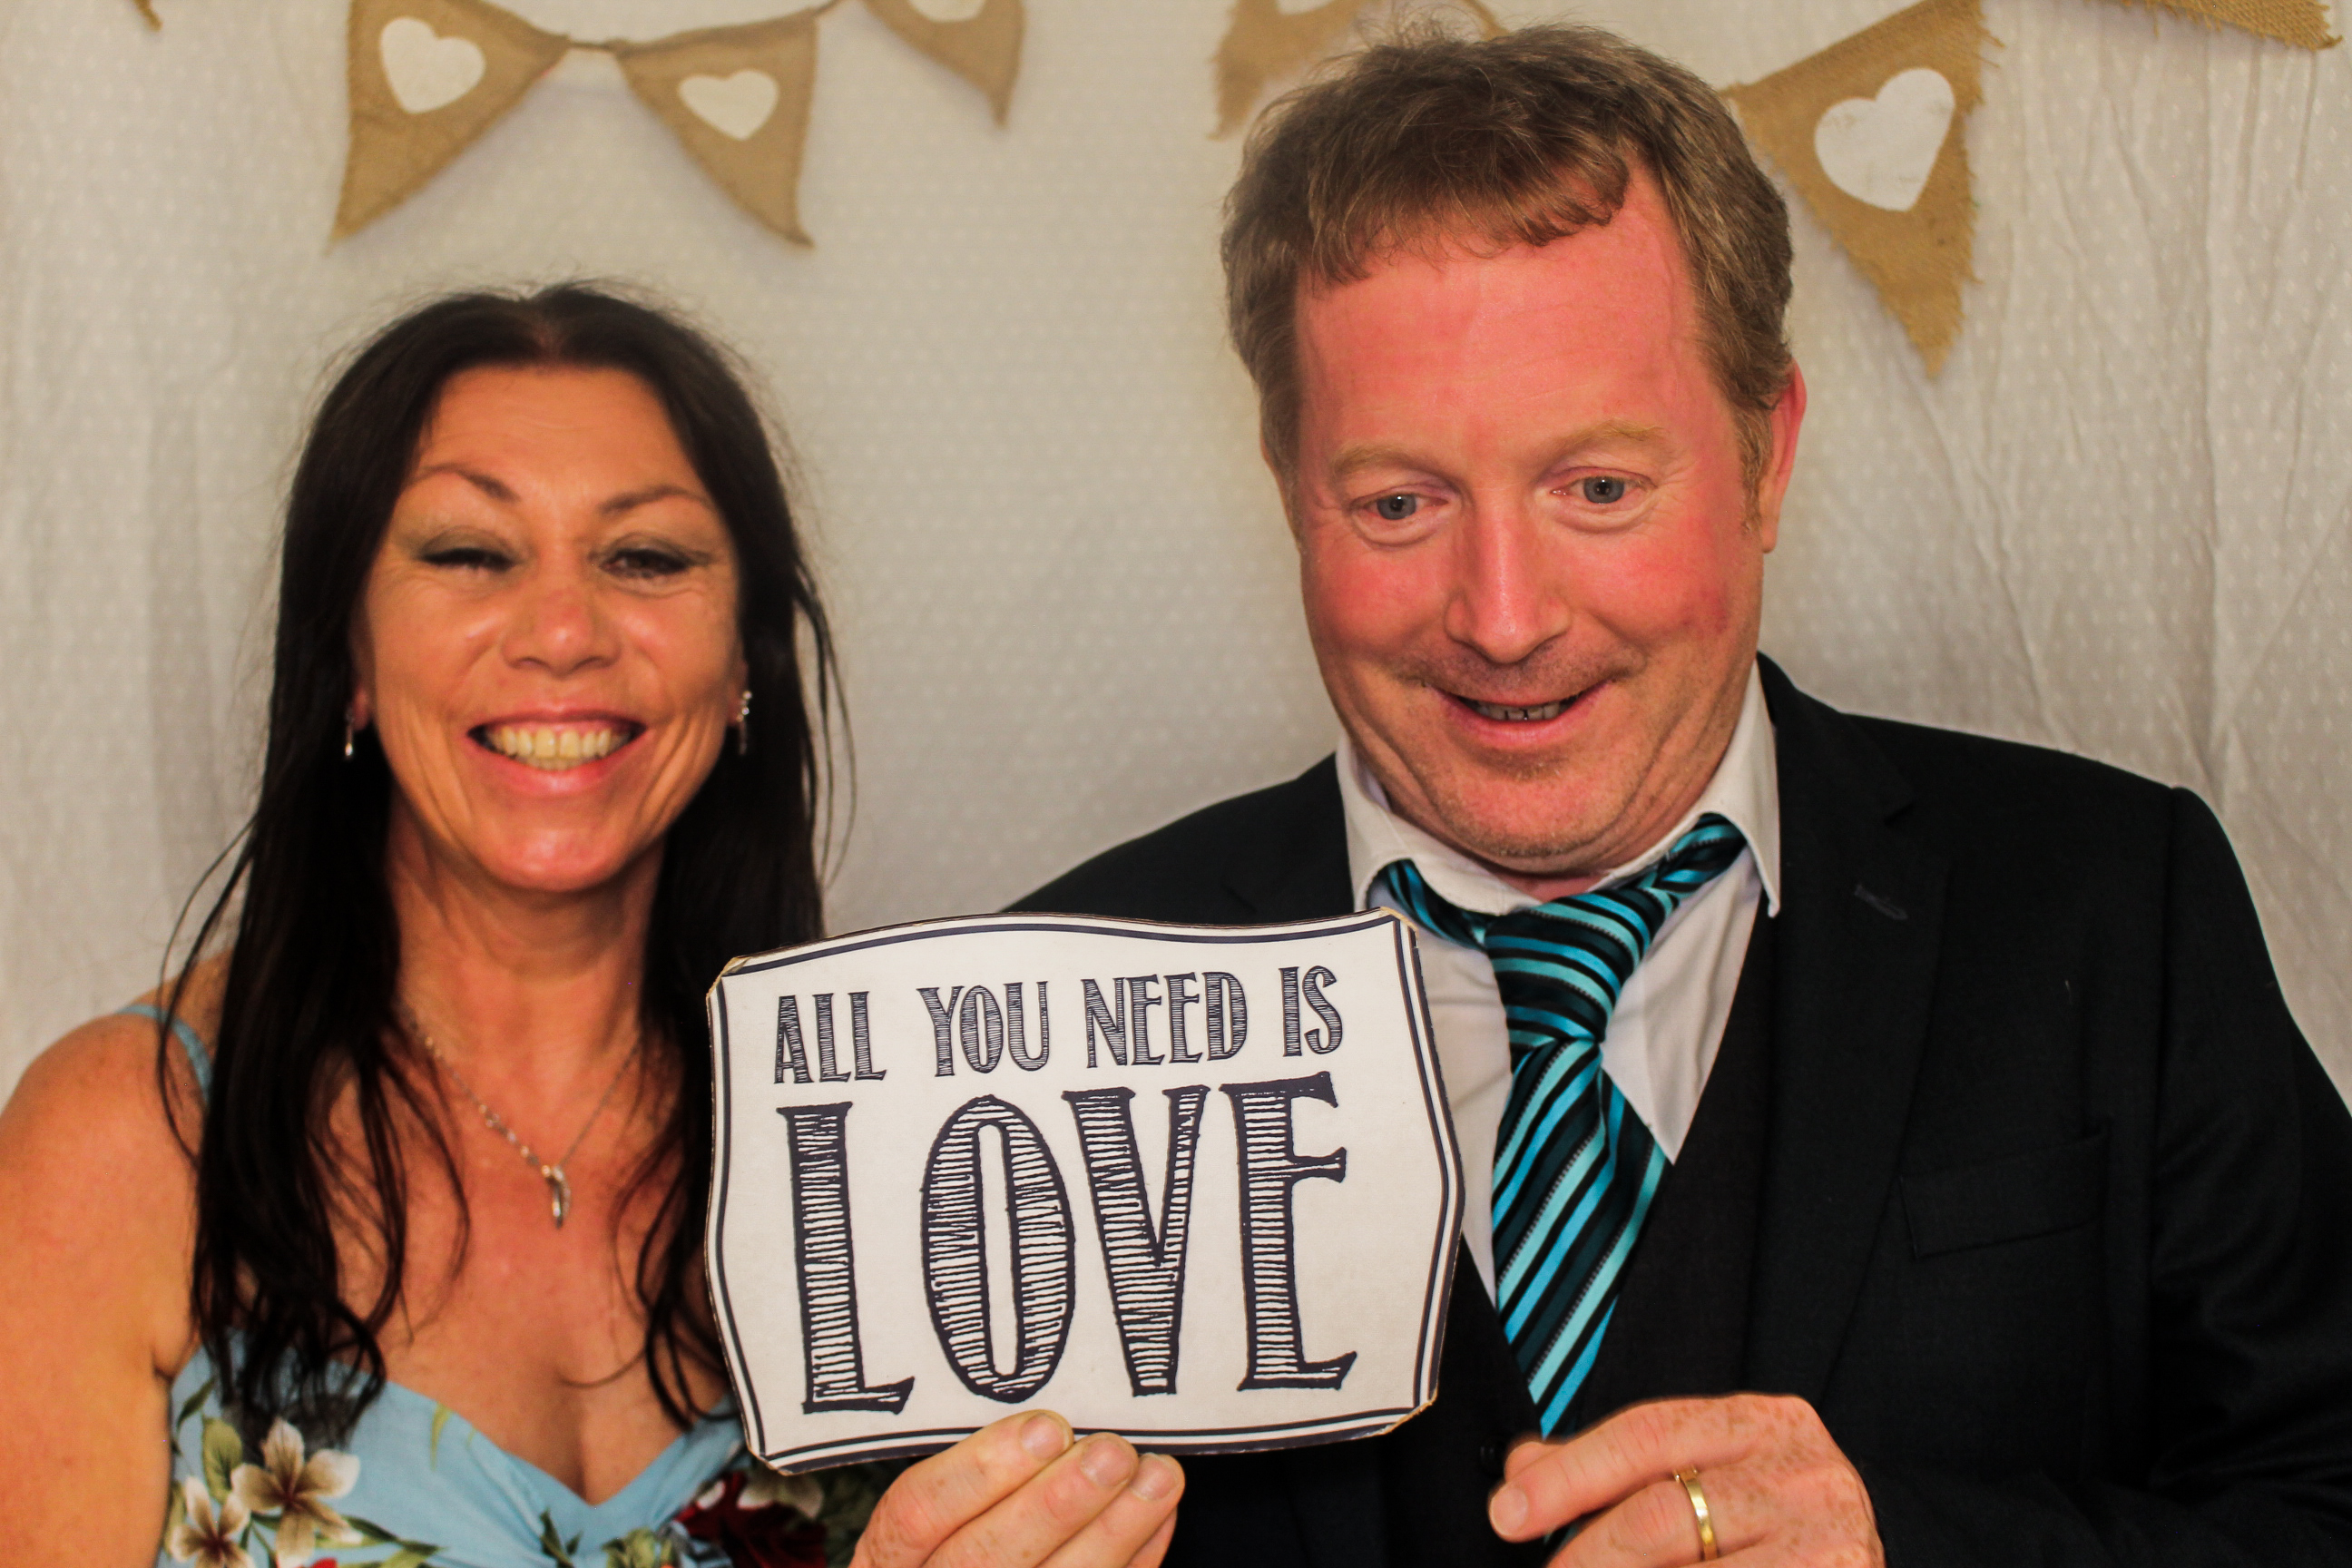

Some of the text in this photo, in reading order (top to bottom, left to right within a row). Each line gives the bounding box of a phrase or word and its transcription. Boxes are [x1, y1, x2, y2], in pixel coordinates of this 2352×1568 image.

[774, 965, 1343, 1084] ALL YOU NEED IS
[777, 1071, 1357, 1415] LOVE
